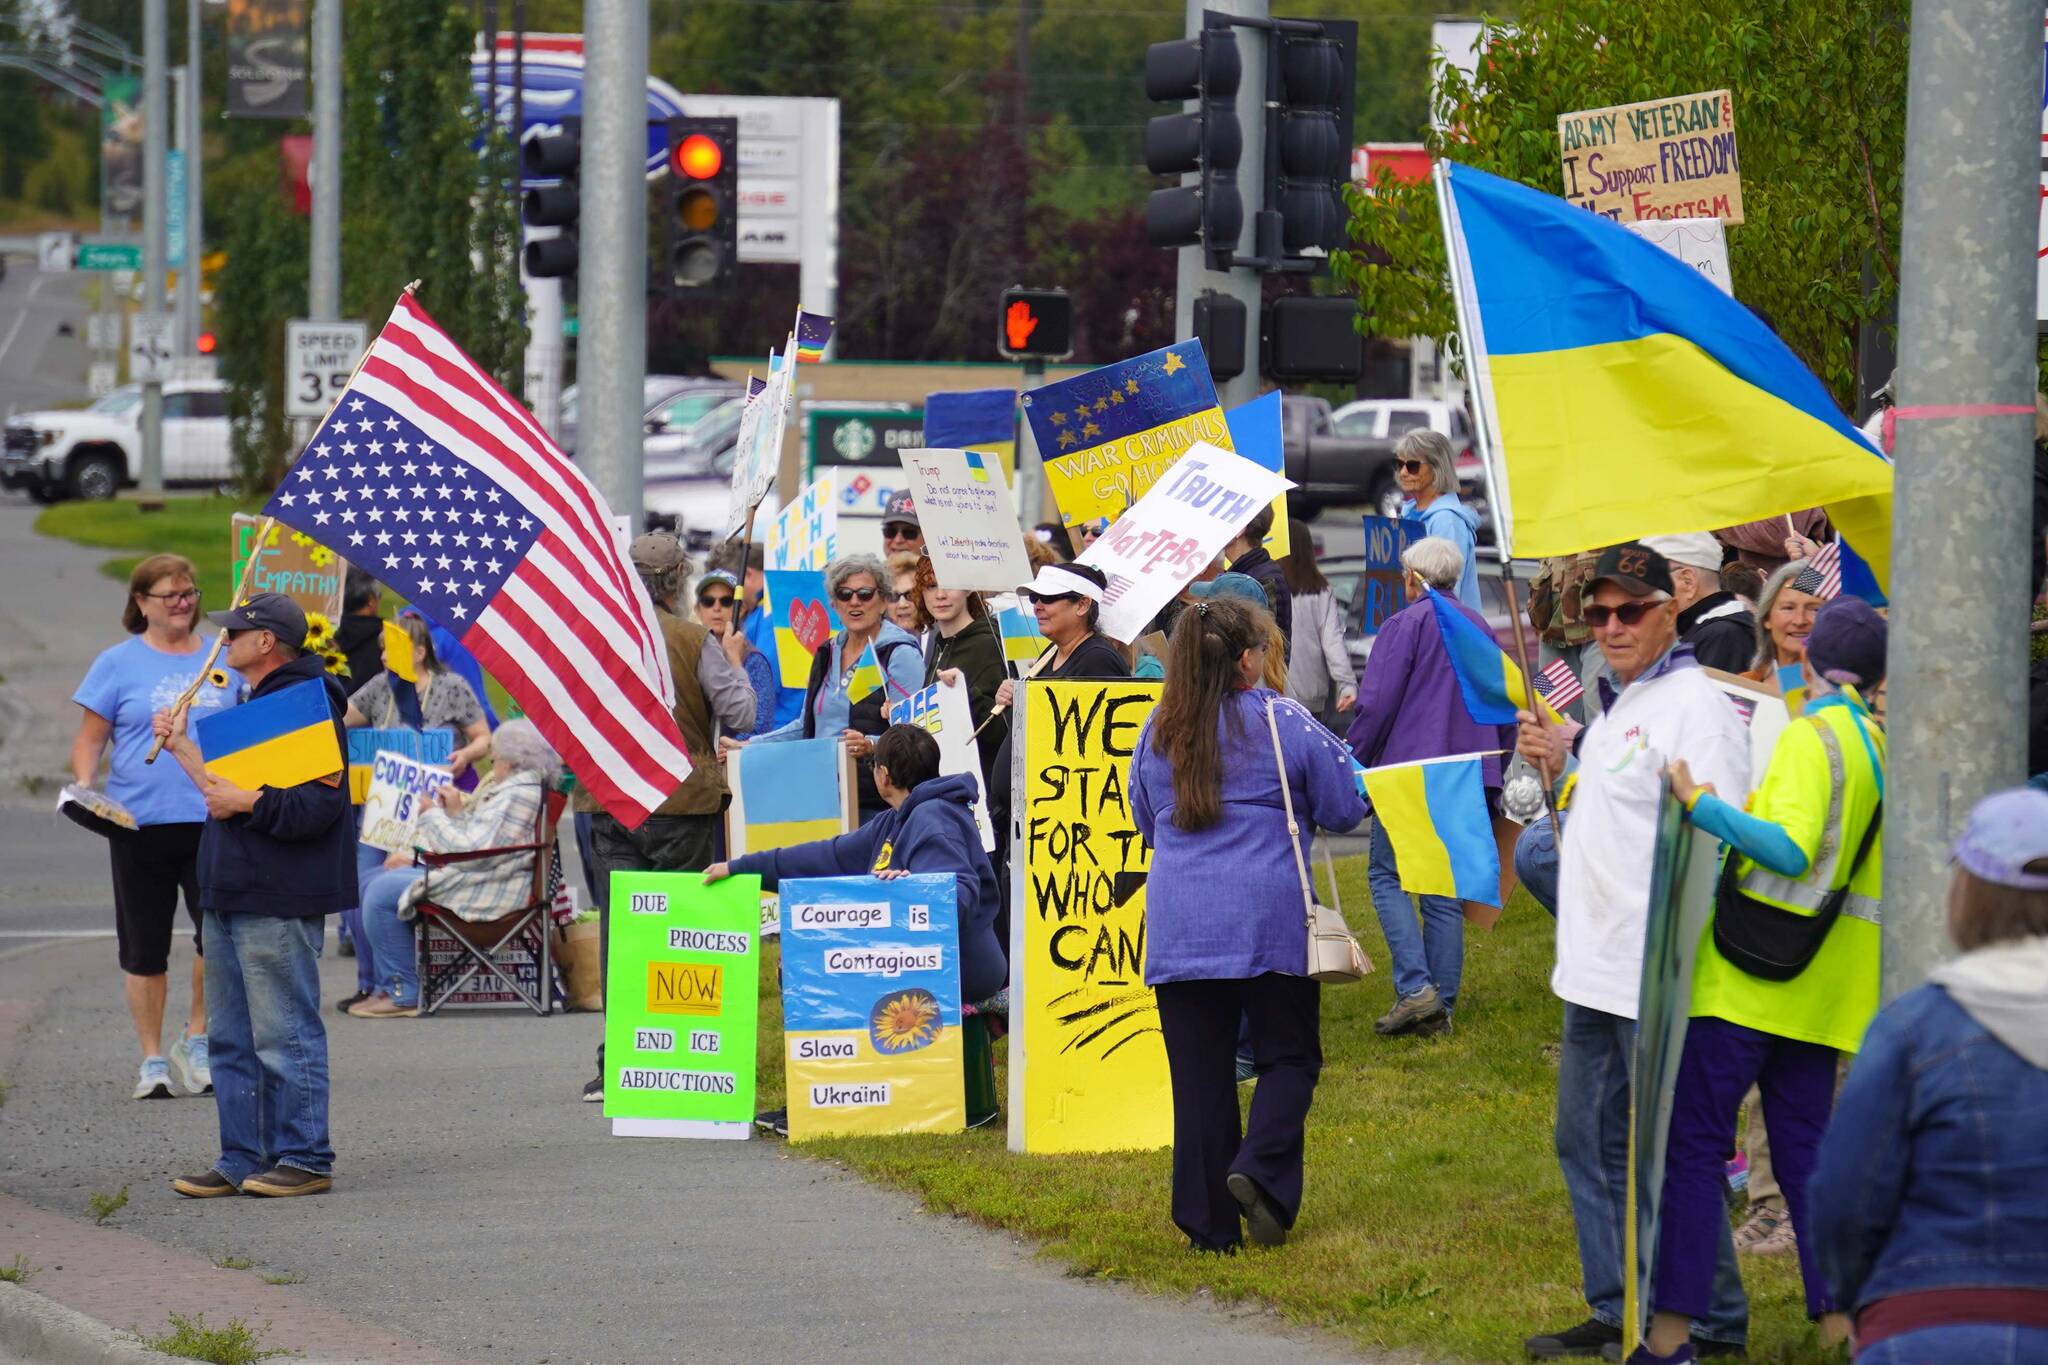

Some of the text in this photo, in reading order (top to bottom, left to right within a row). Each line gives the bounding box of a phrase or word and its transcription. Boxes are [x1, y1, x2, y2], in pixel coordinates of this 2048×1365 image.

[1564, 113, 1617, 151] ARMY
[1626, 96, 1720, 142] VETERAN
[1564, 156, 1584, 198] I
[1660, 132, 1739, 184] FREEDOM
[298, 334, 356, 350] SPEED
[303, 354, 348, 369] LIMIT
[1054, 412, 1227, 481] WAR CRIMINALS
[912, 459, 941, 480] Trump
[1165, 459, 1257, 524] TRUTH
[767, 479, 831, 550] STAND
[775, 511, 823, 571] WITH
[1369, 525, 1392, 564] NO
[1617, 556, 1647, 578] 66
[1044, 686, 1155, 758] WE
[394, 792, 413, 821] IS
[1028, 817, 1099, 868] FOR
[632, 895, 667, 912] DUE
[1032, 869, 1116, 921] WHO
[801, 907, 927, 926] Courage is
[670, 929, 748, 953] PROCESS
[829, 952, 936, 974] Contagious
[656, 968, 717, 1001] NOW
[636, 1032, 719, 1051] END ICE
[800, 1041, 854, 1057] Slava
[621, 1070, 734, 1094] ABDUCTIONS
